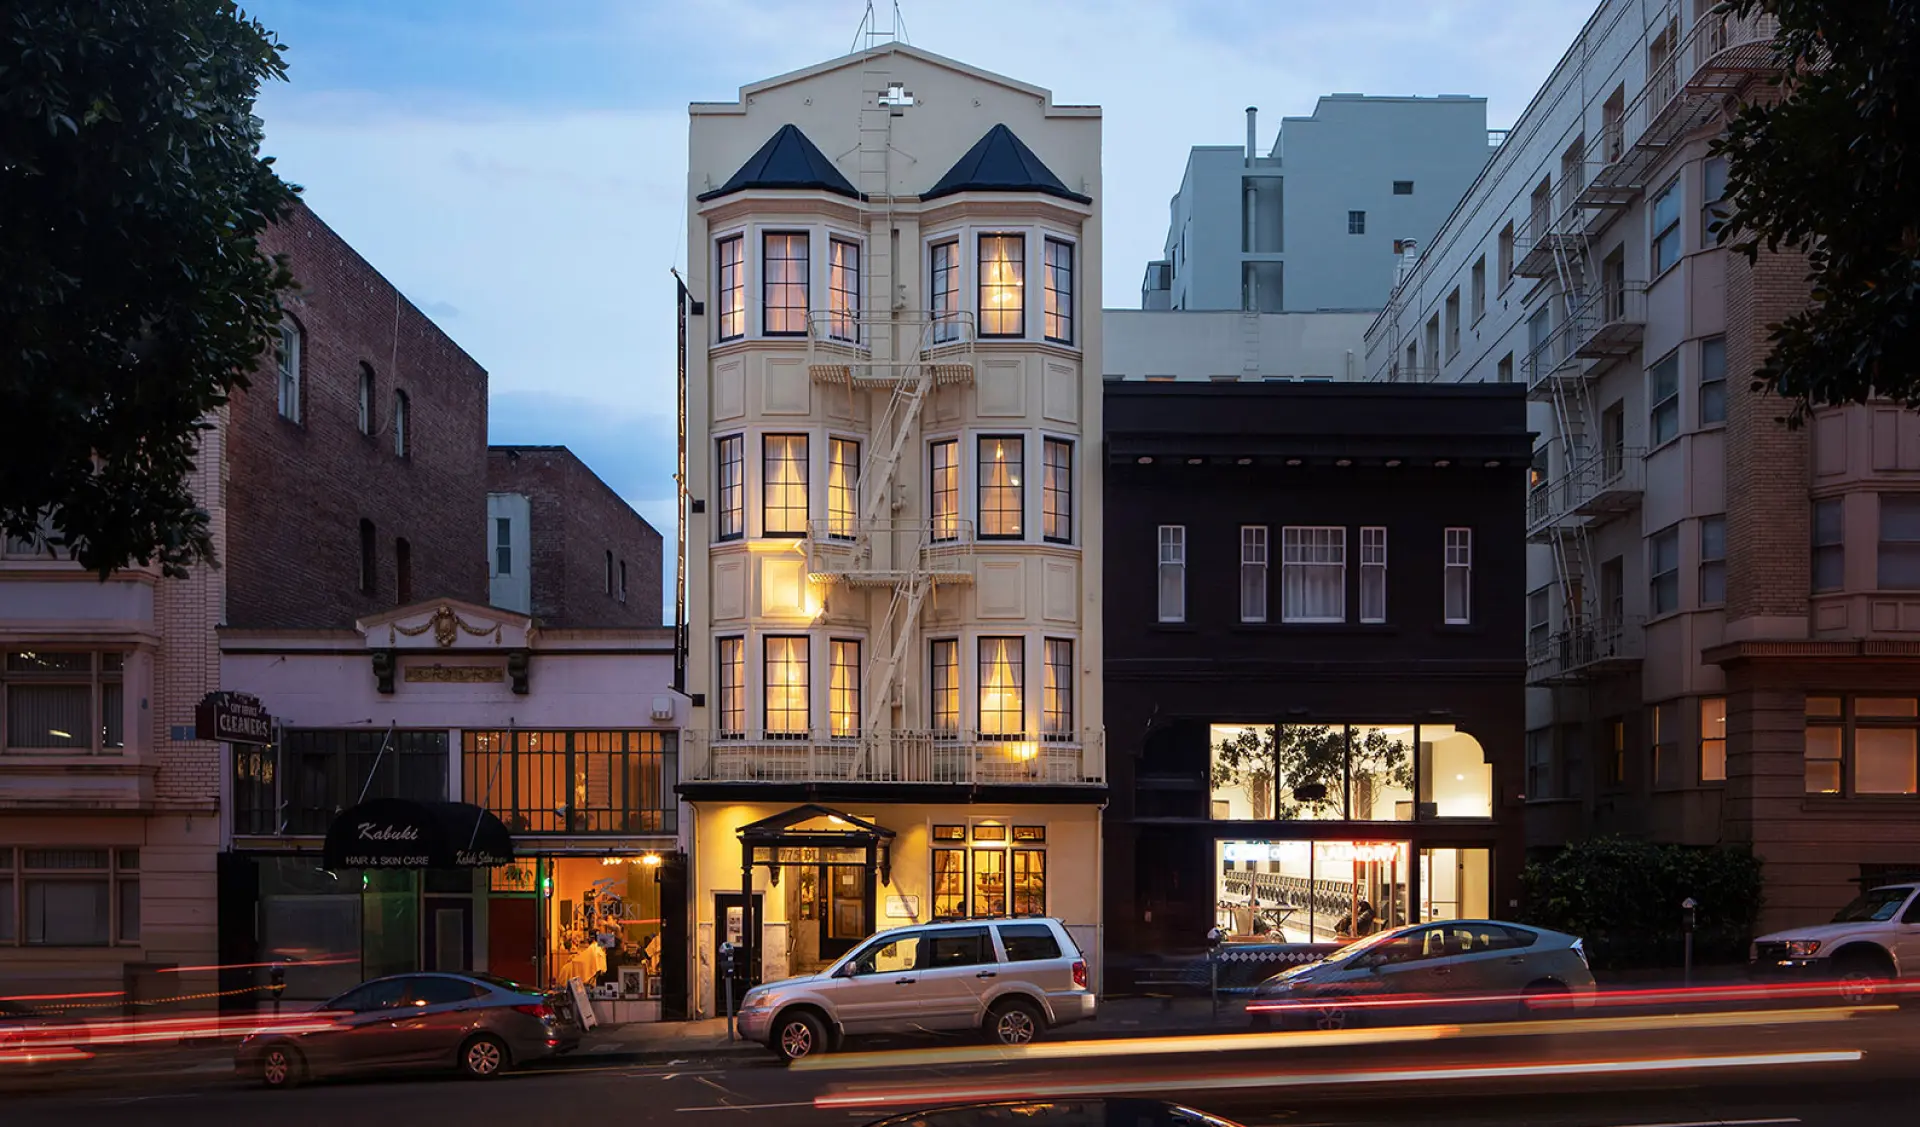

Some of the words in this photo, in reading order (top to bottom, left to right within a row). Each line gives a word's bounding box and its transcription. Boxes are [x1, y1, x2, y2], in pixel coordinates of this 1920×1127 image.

[219, 714, 268, 737] CLEANERS
[357, 821, 419, 841] Kabuki
[346, 856, 369, 866] HAIR
[370, 855, 377, 866] &
[380, 855, 402, 866] SKIN
[404, 856, 429, 866] CARE
[574, 901, 641, 920] KABUKI
